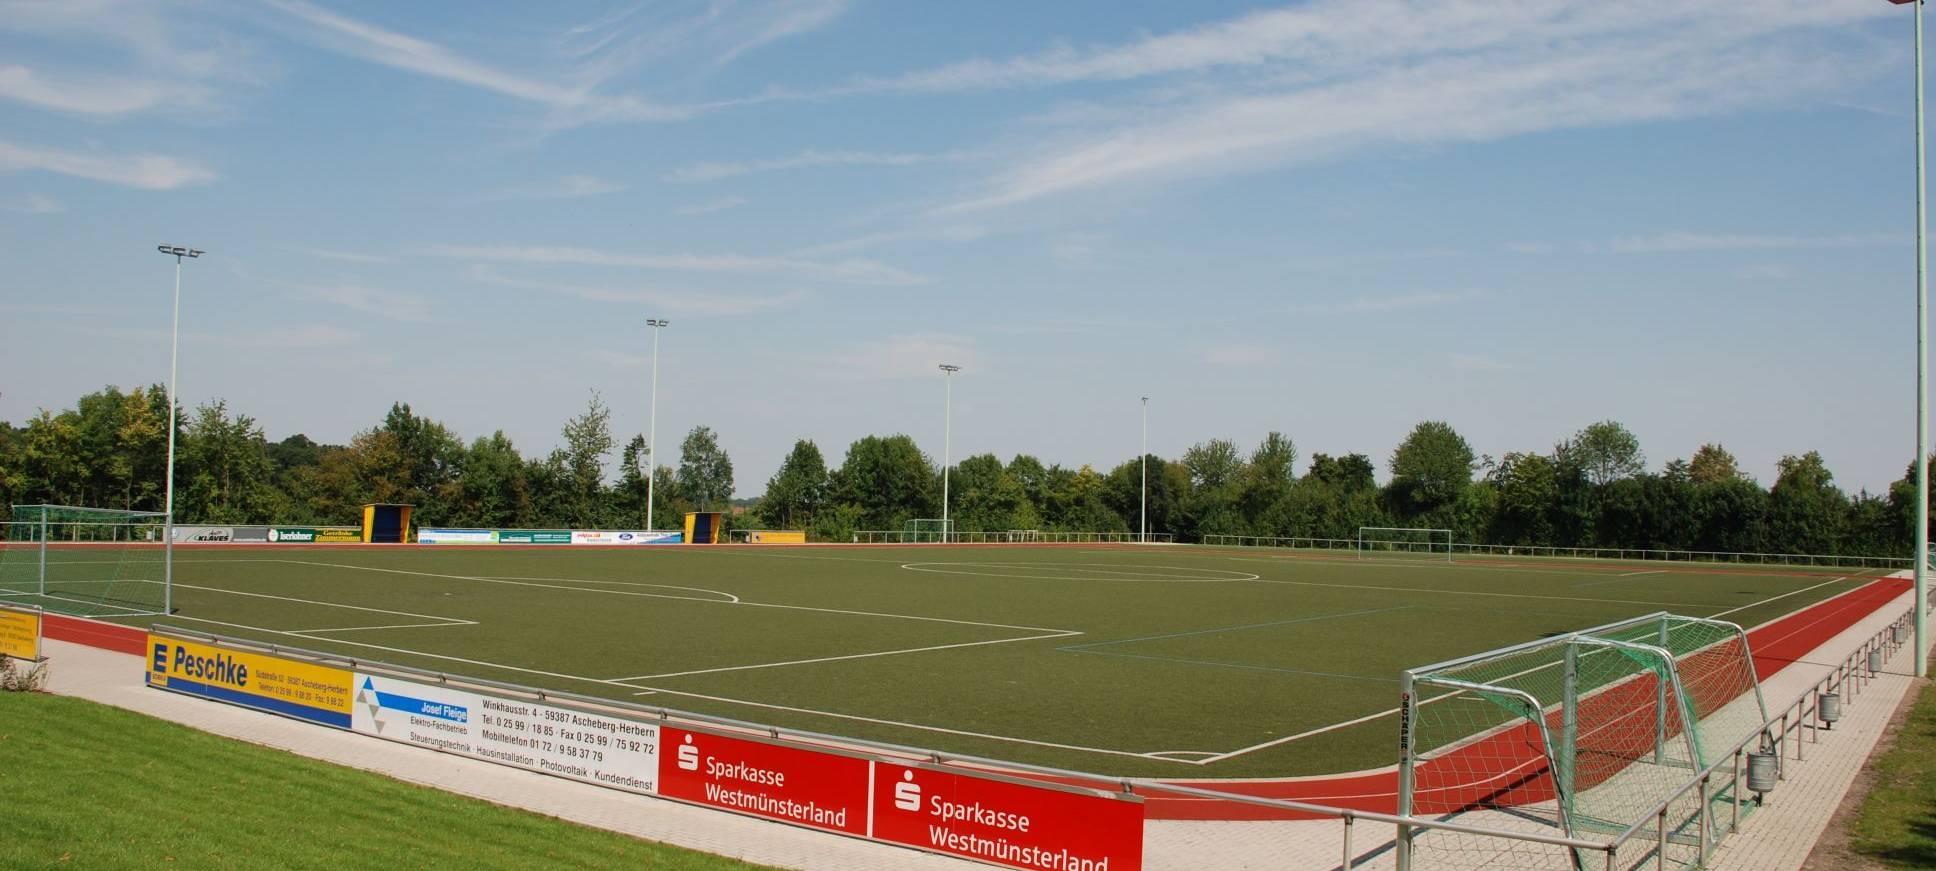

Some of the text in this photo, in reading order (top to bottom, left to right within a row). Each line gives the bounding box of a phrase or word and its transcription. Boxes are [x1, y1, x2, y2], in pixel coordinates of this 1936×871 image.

[173, 646, 248, 687] Peschke
[410, 716, 468, 735] Elektro-Fachbetrieb
[421, 702, 468, 721] Josef Fleige
[482, 699, 530, 717] Winkhausstr.
[532, 708, 537, 717] 4
[545, 710, 570, 724] 59387
[572, 715, 655, 738] Ascheberg-Herbern
[482, 714, 495, 726] Tel.
[496, 718, 501, 727] 0
[503, 718, 513, 729] 25
[515, 720, 525, 731] 99
[533, 724, 542, 735] 18
[544, 725, 553, 737] 85
[560, 729, 574, 740] Fax
[576, 730, 582, 742] 0
[584, 733, 594, 744] 25
[597, 735, 607, 746] 99
[616, 738, 627, 750] 75
[629, 740, 640, 753] 92
[644, 743, 654, 755] 72
[482, 729, 528, 747] Mobiltelefon
[530, 738, 539, 750] 01
[542, 740, 552, 752] 72
[559, 744, 565, 754] 9
[566, 745, 577, 757] 58
[579, 748, 590, 760] 37
[592, 750, 603, 762] 79
[410, 731, 653, 791] Steuerungstechnik Hausinstallation Photovoltaik Kundendienst
[705, 756, 785, 787] Sparkasse
[705, 782, 846, 828] Westmünsterland
[930, 795, 1030, 833] Sparkasse
[930, 823, 1109, 871] Westmünsterland
